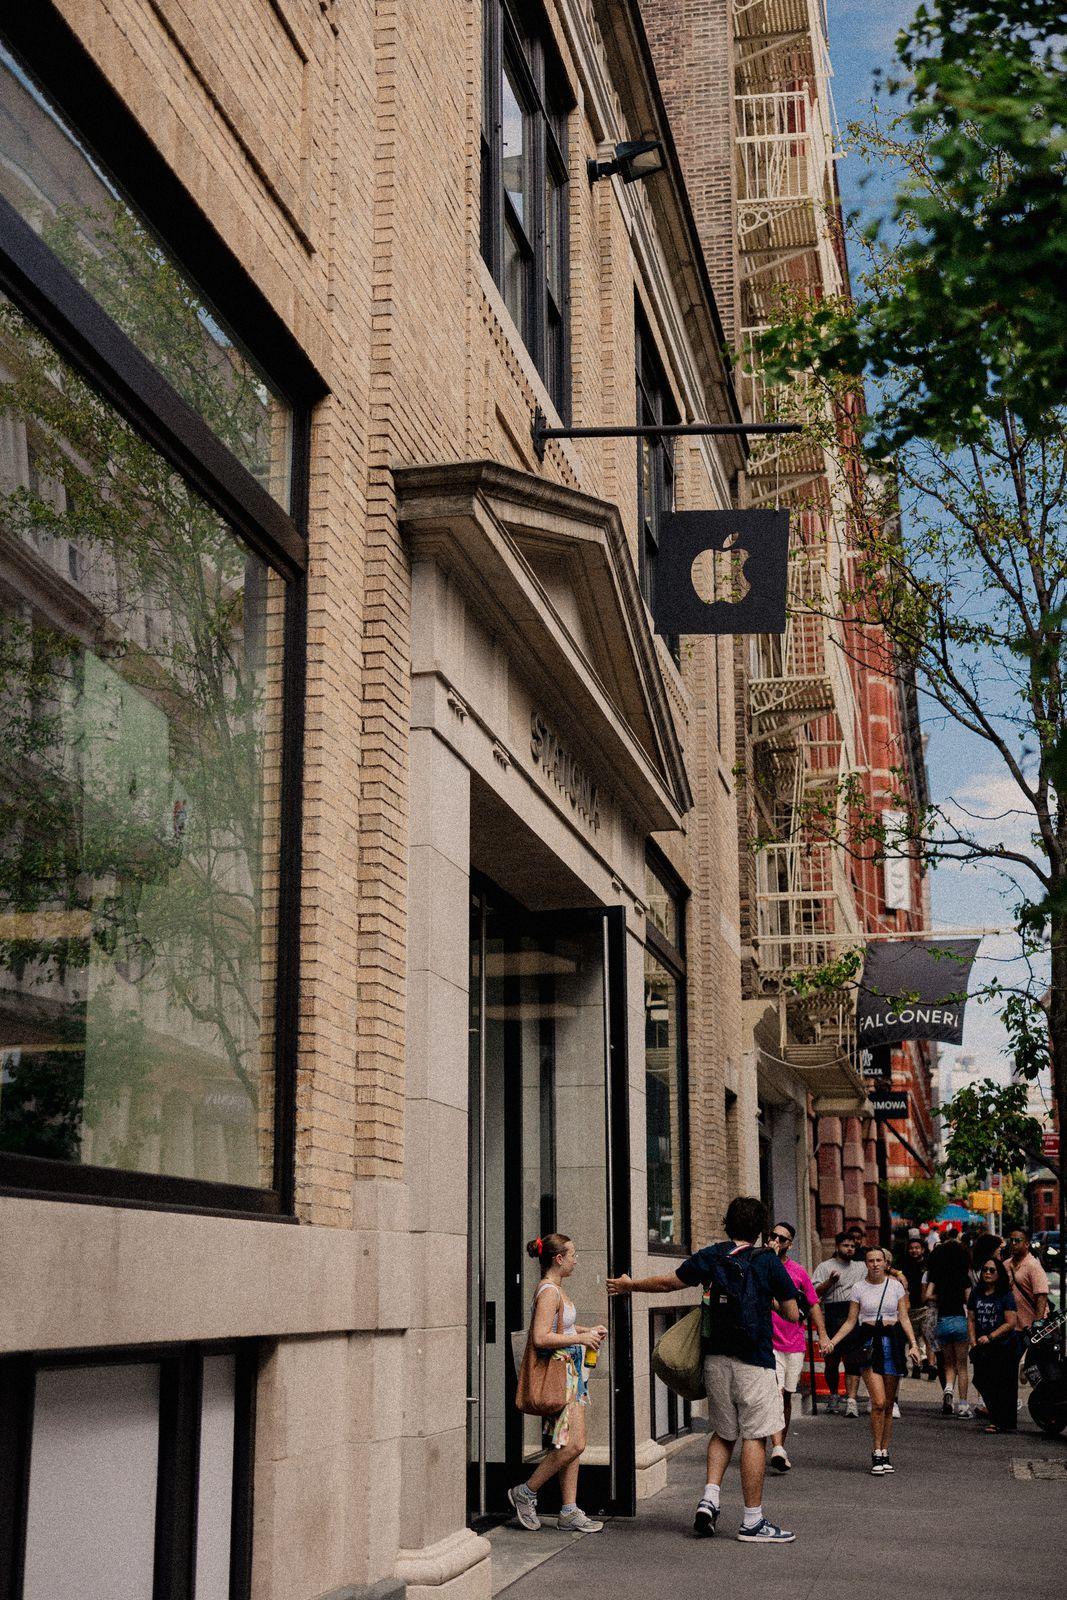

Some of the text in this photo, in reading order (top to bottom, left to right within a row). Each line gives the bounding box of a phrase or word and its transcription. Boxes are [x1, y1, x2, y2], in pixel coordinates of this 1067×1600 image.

[530, 711, 591, 820] STATION
[859, 1009, 959, 1032] FALCONERI
[856, 1068, 883, 1076] ONCLER
[873, 1100, 907, 1110] IMOWA
